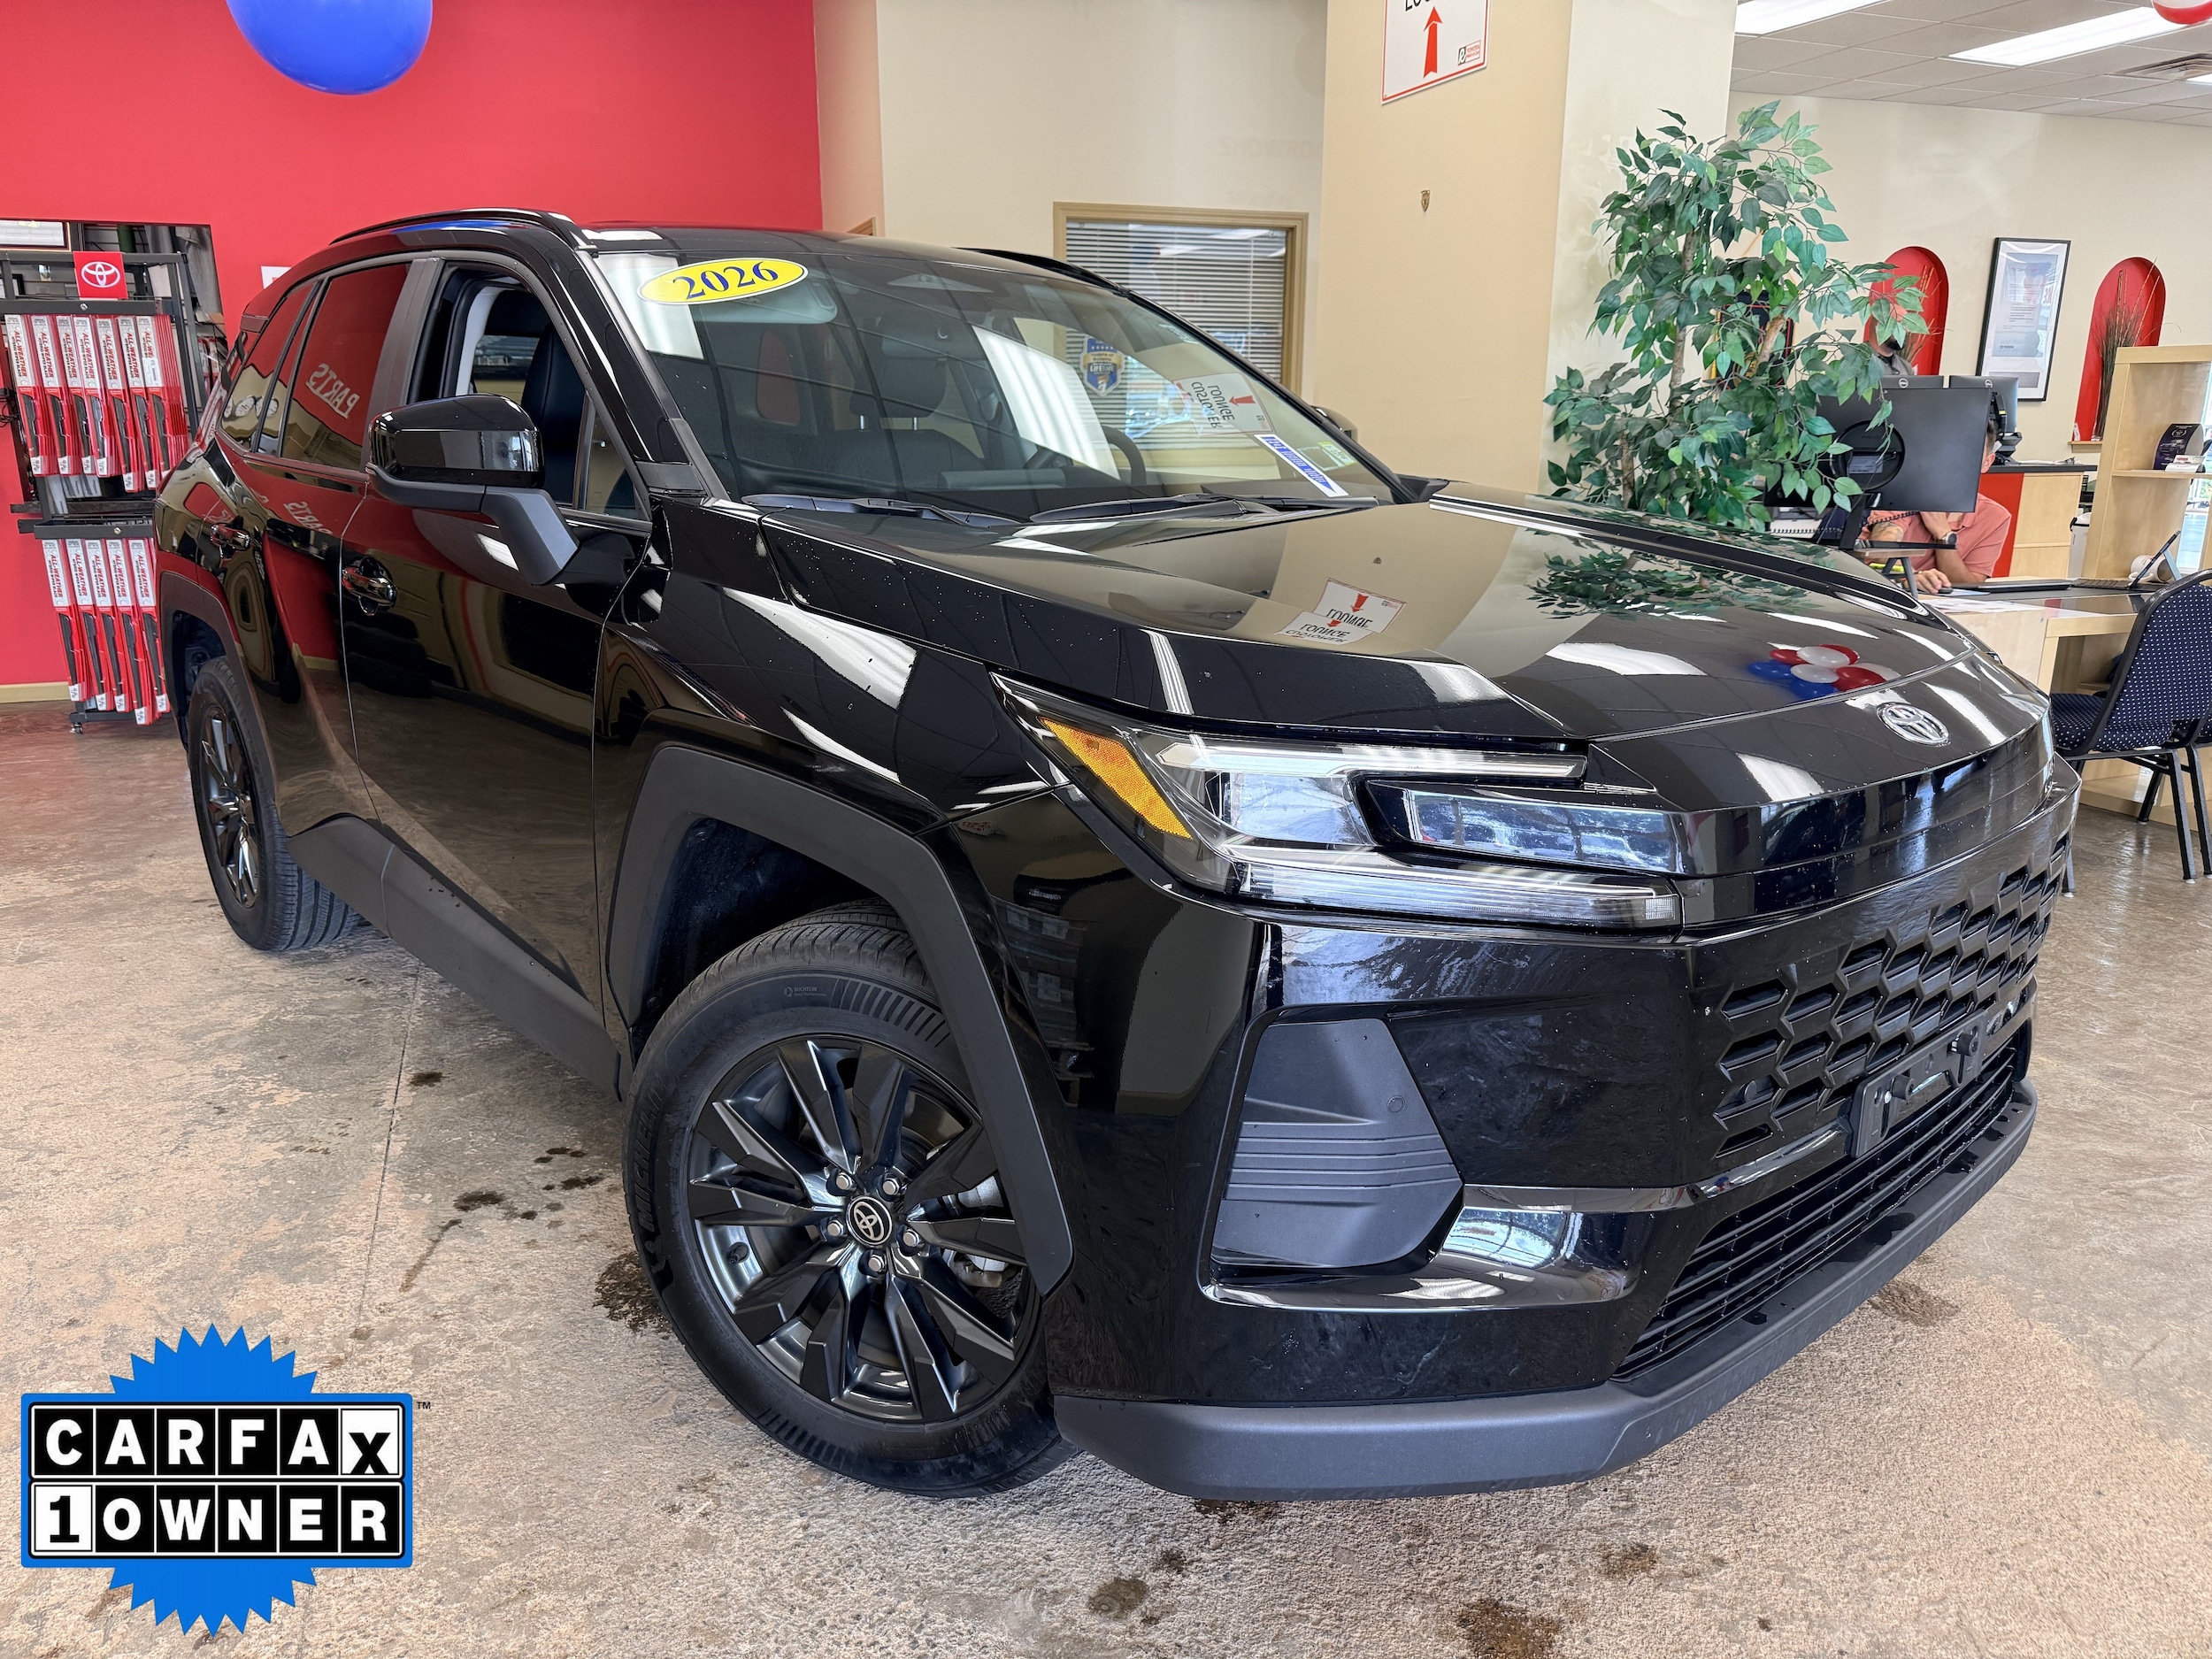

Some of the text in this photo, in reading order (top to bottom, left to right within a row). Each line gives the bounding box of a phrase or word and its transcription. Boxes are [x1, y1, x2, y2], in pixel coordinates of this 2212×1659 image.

[672, 261, 779, 300] 2026
[14, 331, 27, 378] ALL-WEATHER
[41, 332, 54, 378] ALL-WEATHER
[65, 333, 77, 378] ALL-WEATHER
[82, 333, 95, 379] ALL-WEATHER
[104, 334, 118, 380] ALL-WEATHER
[127, 333, 139, 378] ALL-WEATHER
[50, 555, 63, 597] ALL-WEATHER
[74, 553, 87, 596] ALL-WEATHER
[95, 555, 106, 597] ALL-WEATHER
[114, 555, 127, 597] ALL-WEATHER
[137, 555, 150, 597] ALL-WEATHER
